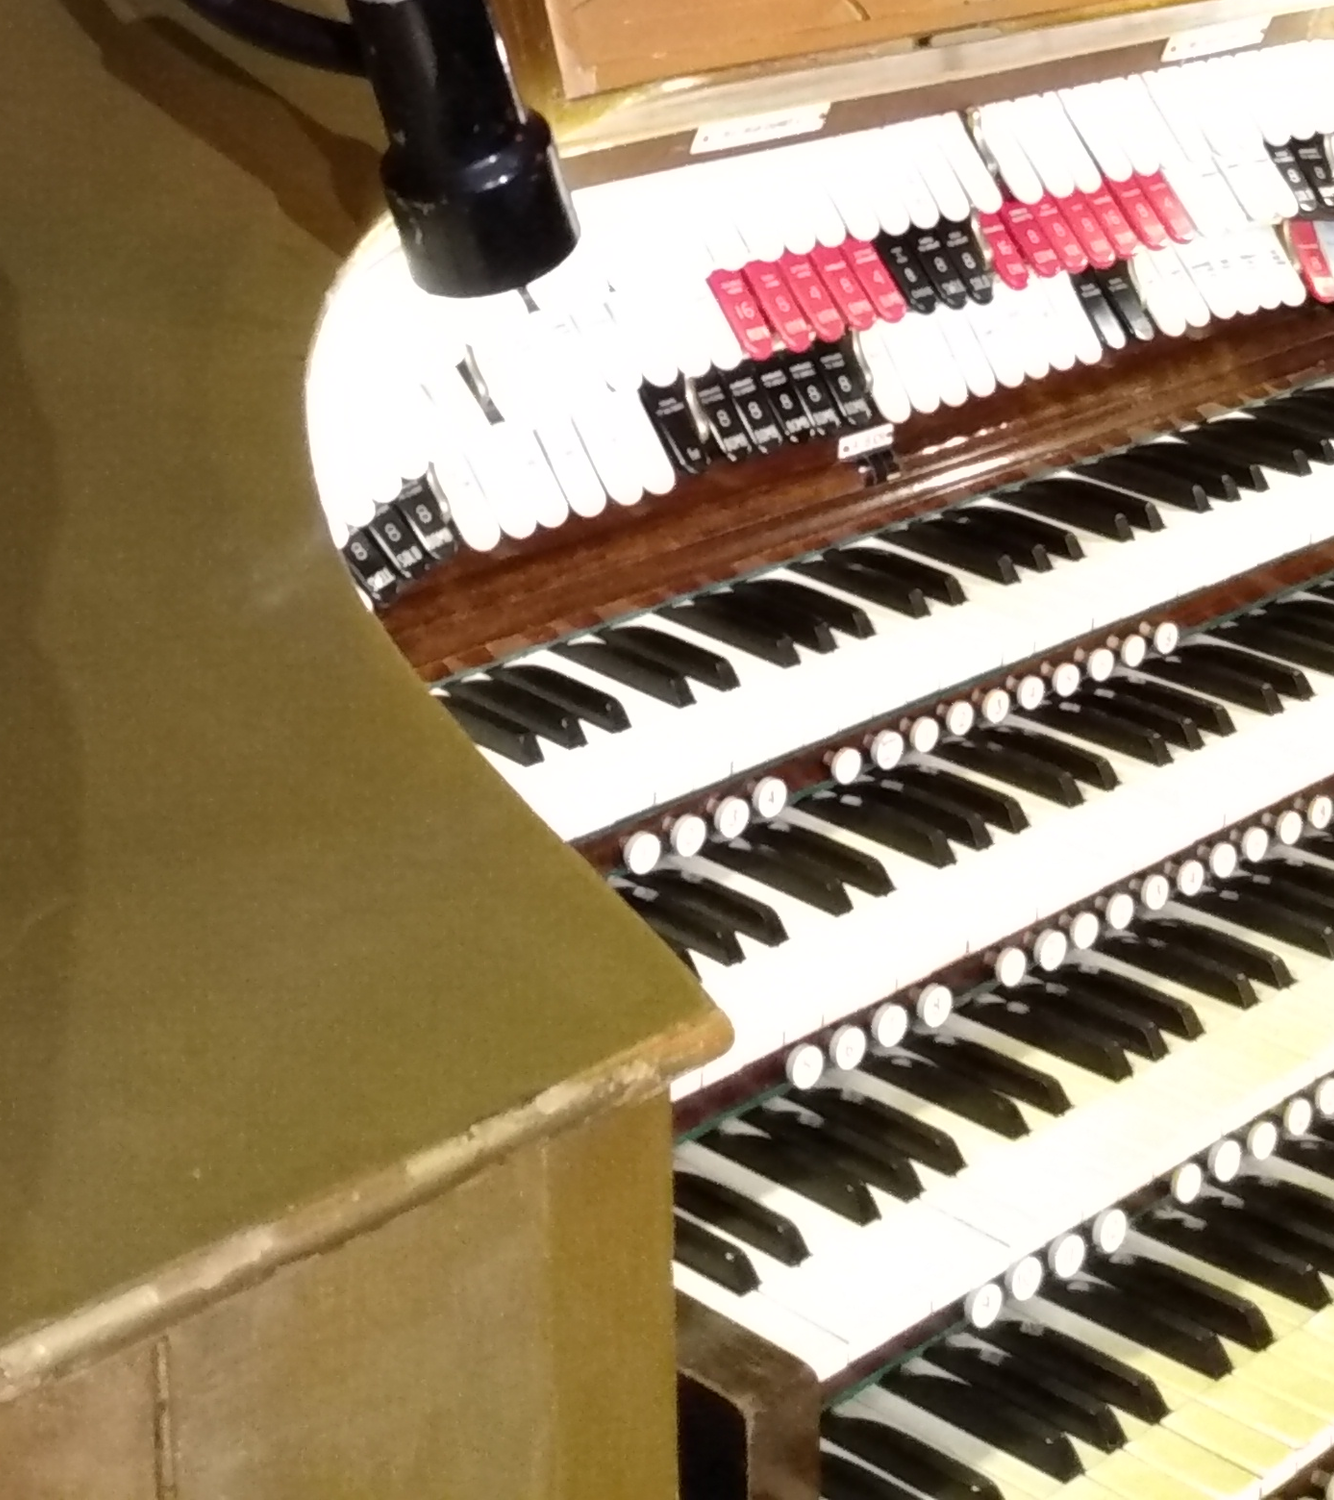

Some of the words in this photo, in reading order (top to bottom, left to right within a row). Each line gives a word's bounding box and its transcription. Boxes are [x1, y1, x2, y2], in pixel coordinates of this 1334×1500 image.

[736, 301, 755, 320] 16
[807, 384, 822, 403] 8
[838, 375, 852, 393] 8
[748, 401, 762, 420] 8
[779, 393, 793, 410] 8
[717, 409, 731, 427] 8
[416, 504, 432, 523] 8
[385, 522, 402, 542] 8
[351, 541, 368, 561] 8
